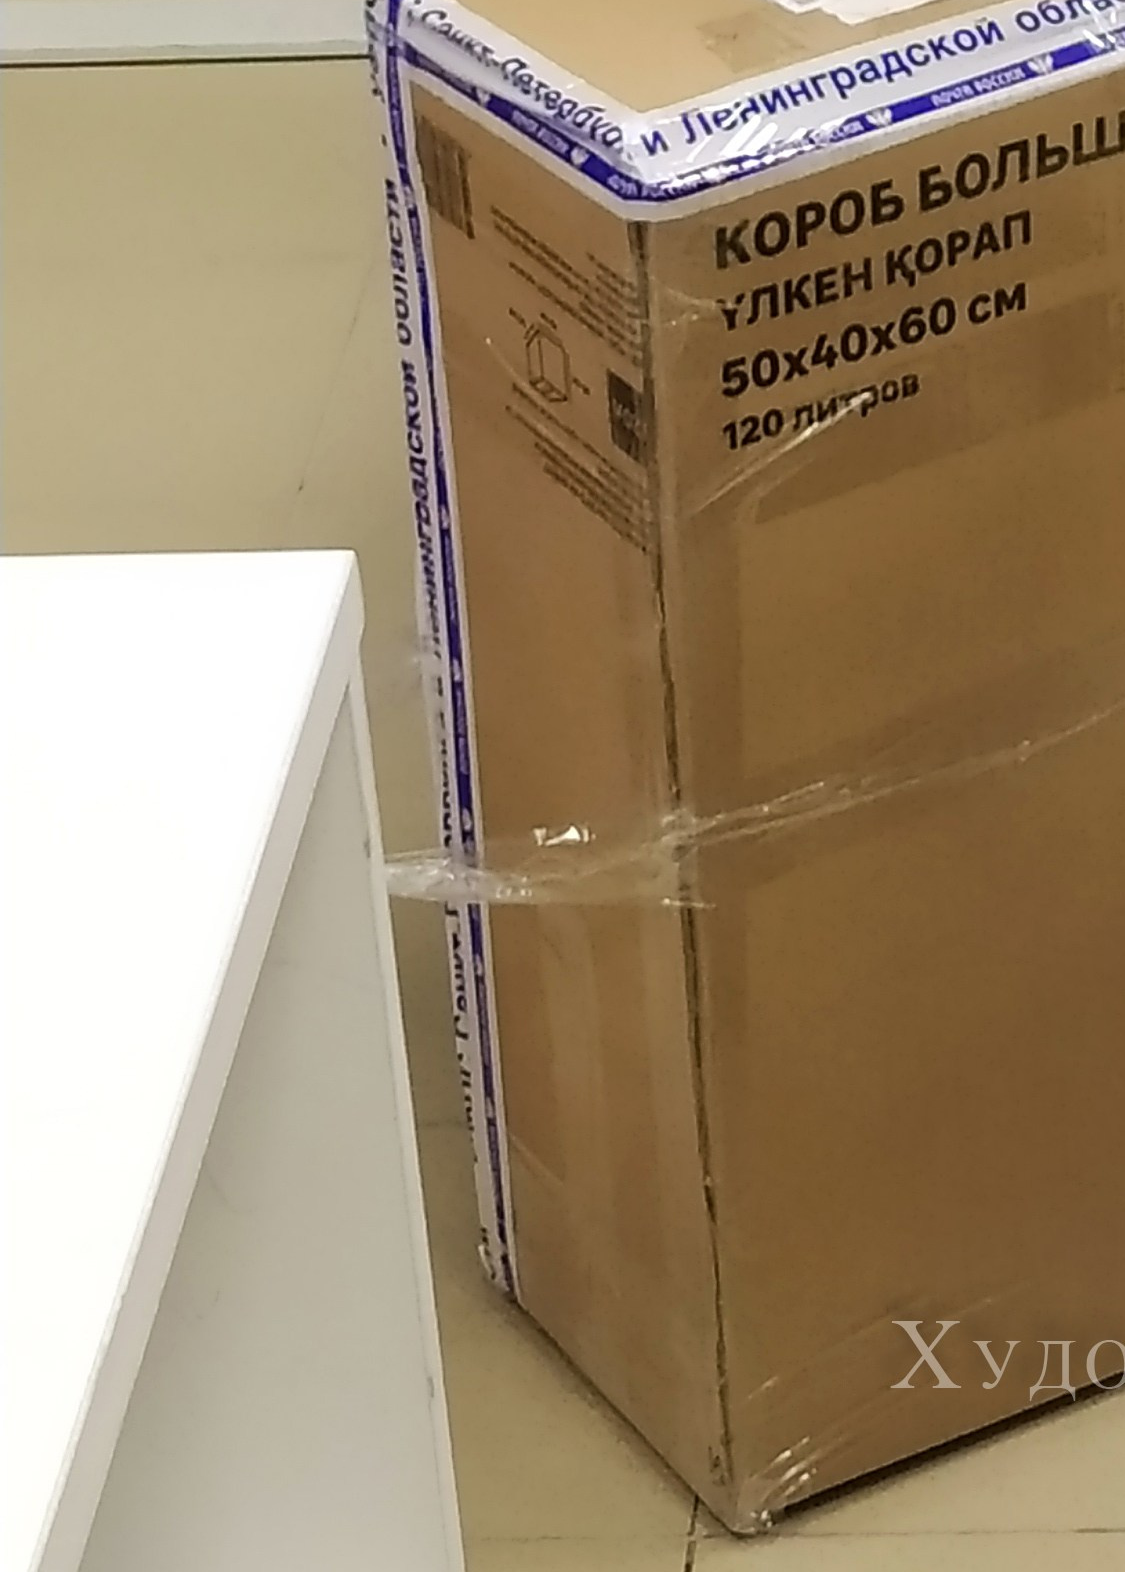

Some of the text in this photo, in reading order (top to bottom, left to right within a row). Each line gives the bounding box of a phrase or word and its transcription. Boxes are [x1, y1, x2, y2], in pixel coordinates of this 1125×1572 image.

[640, 129, 669, 156] и
[680, 17, 1005, 144] Ленинградской
[714, 179, 904, 270] КОРОБ
[884, 210, 1032, 288] ҚОРАП
[968, 282, 1028, 325] см
[722, 372, 921, 450] 120 литров
